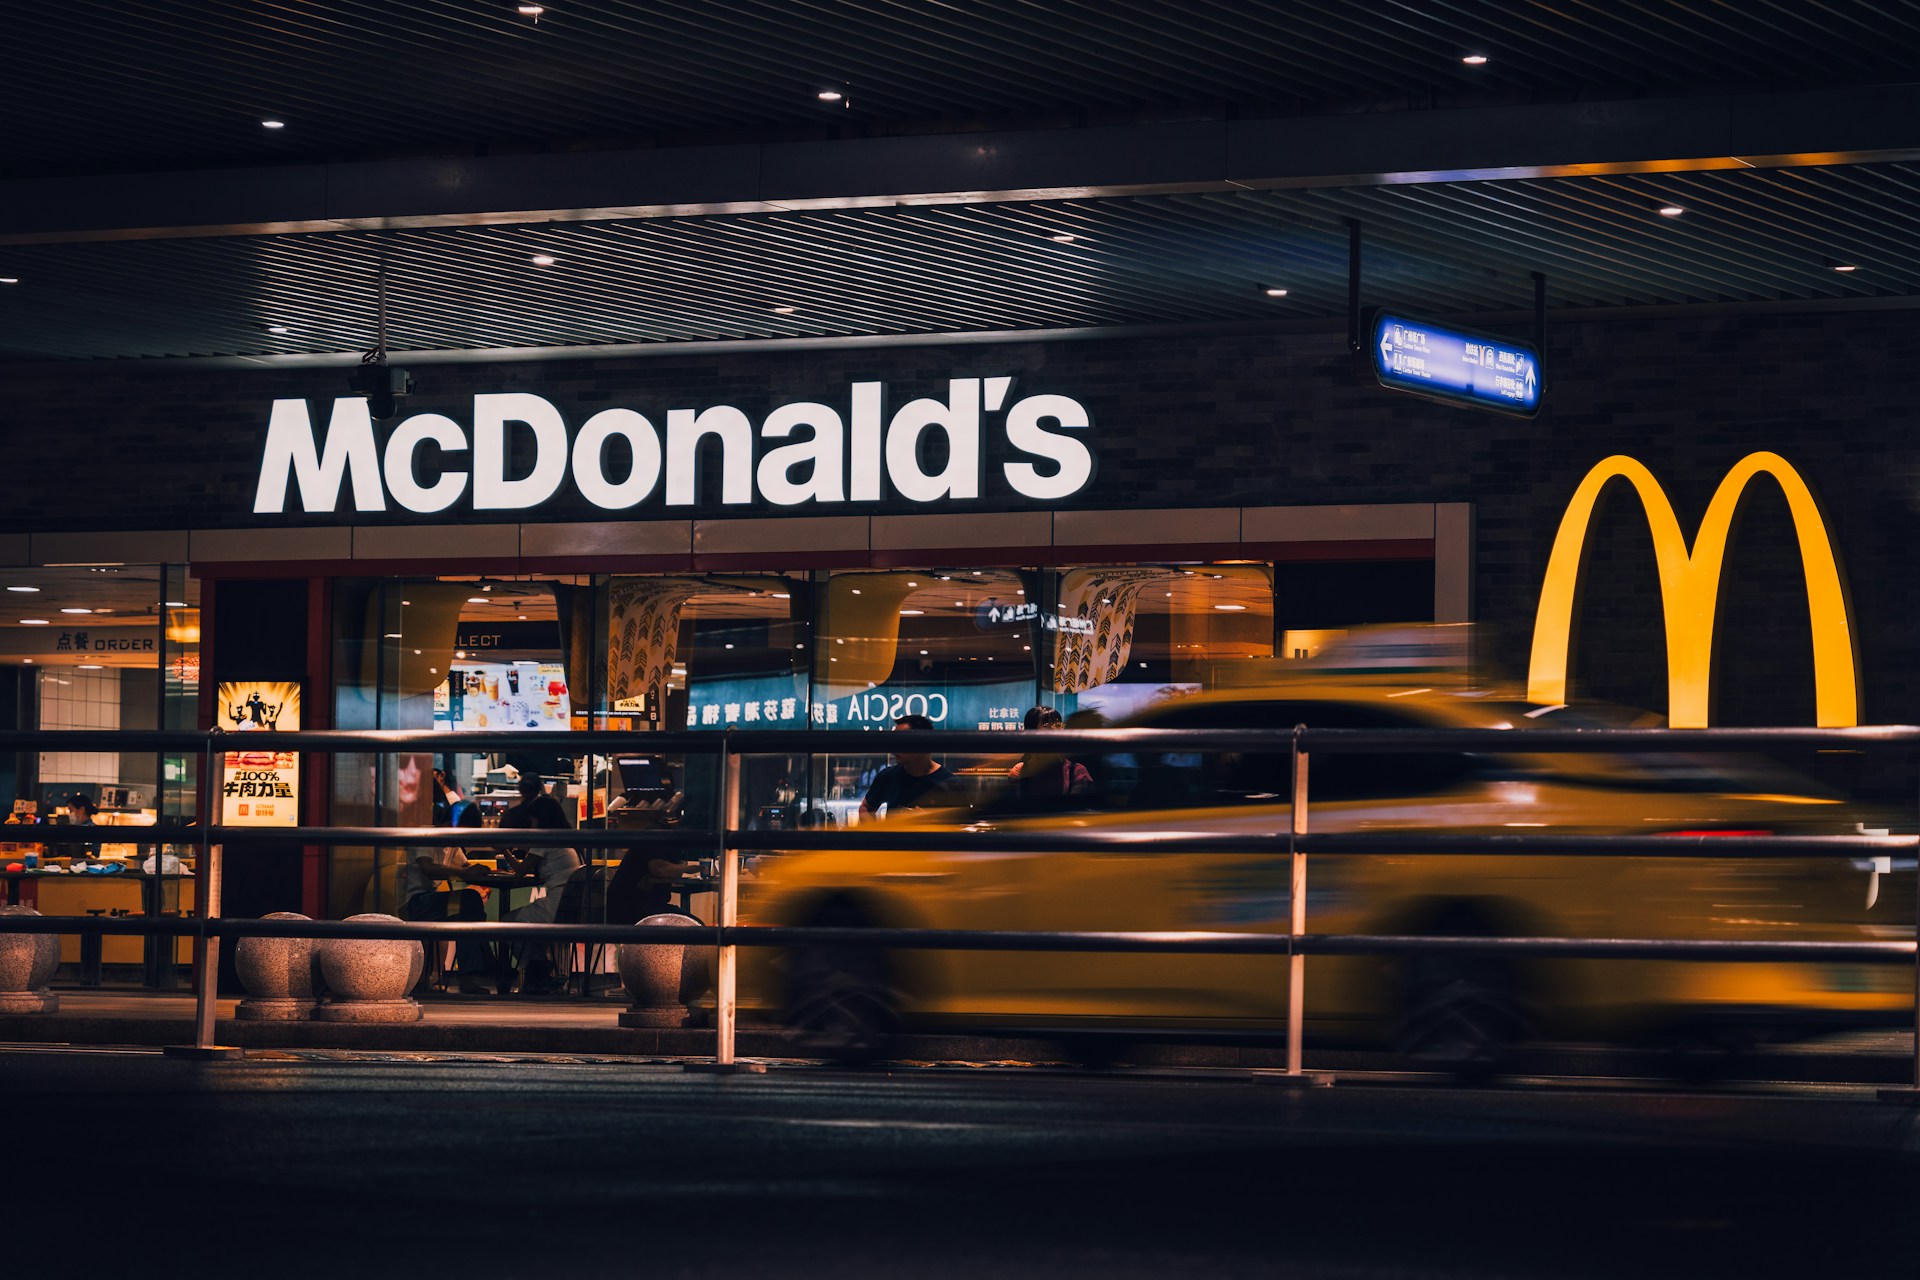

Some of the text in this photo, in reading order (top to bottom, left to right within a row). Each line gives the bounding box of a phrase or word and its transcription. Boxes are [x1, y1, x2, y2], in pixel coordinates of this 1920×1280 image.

[253, 376, 1092, 514] McDonald's
[56, 631, 153, 651] 点餐 ORDER
[454, 634, 502, 648] LECT
[241, 771, 280, 782] 100%
[223, 782, 294, 798] 牛肉力量
